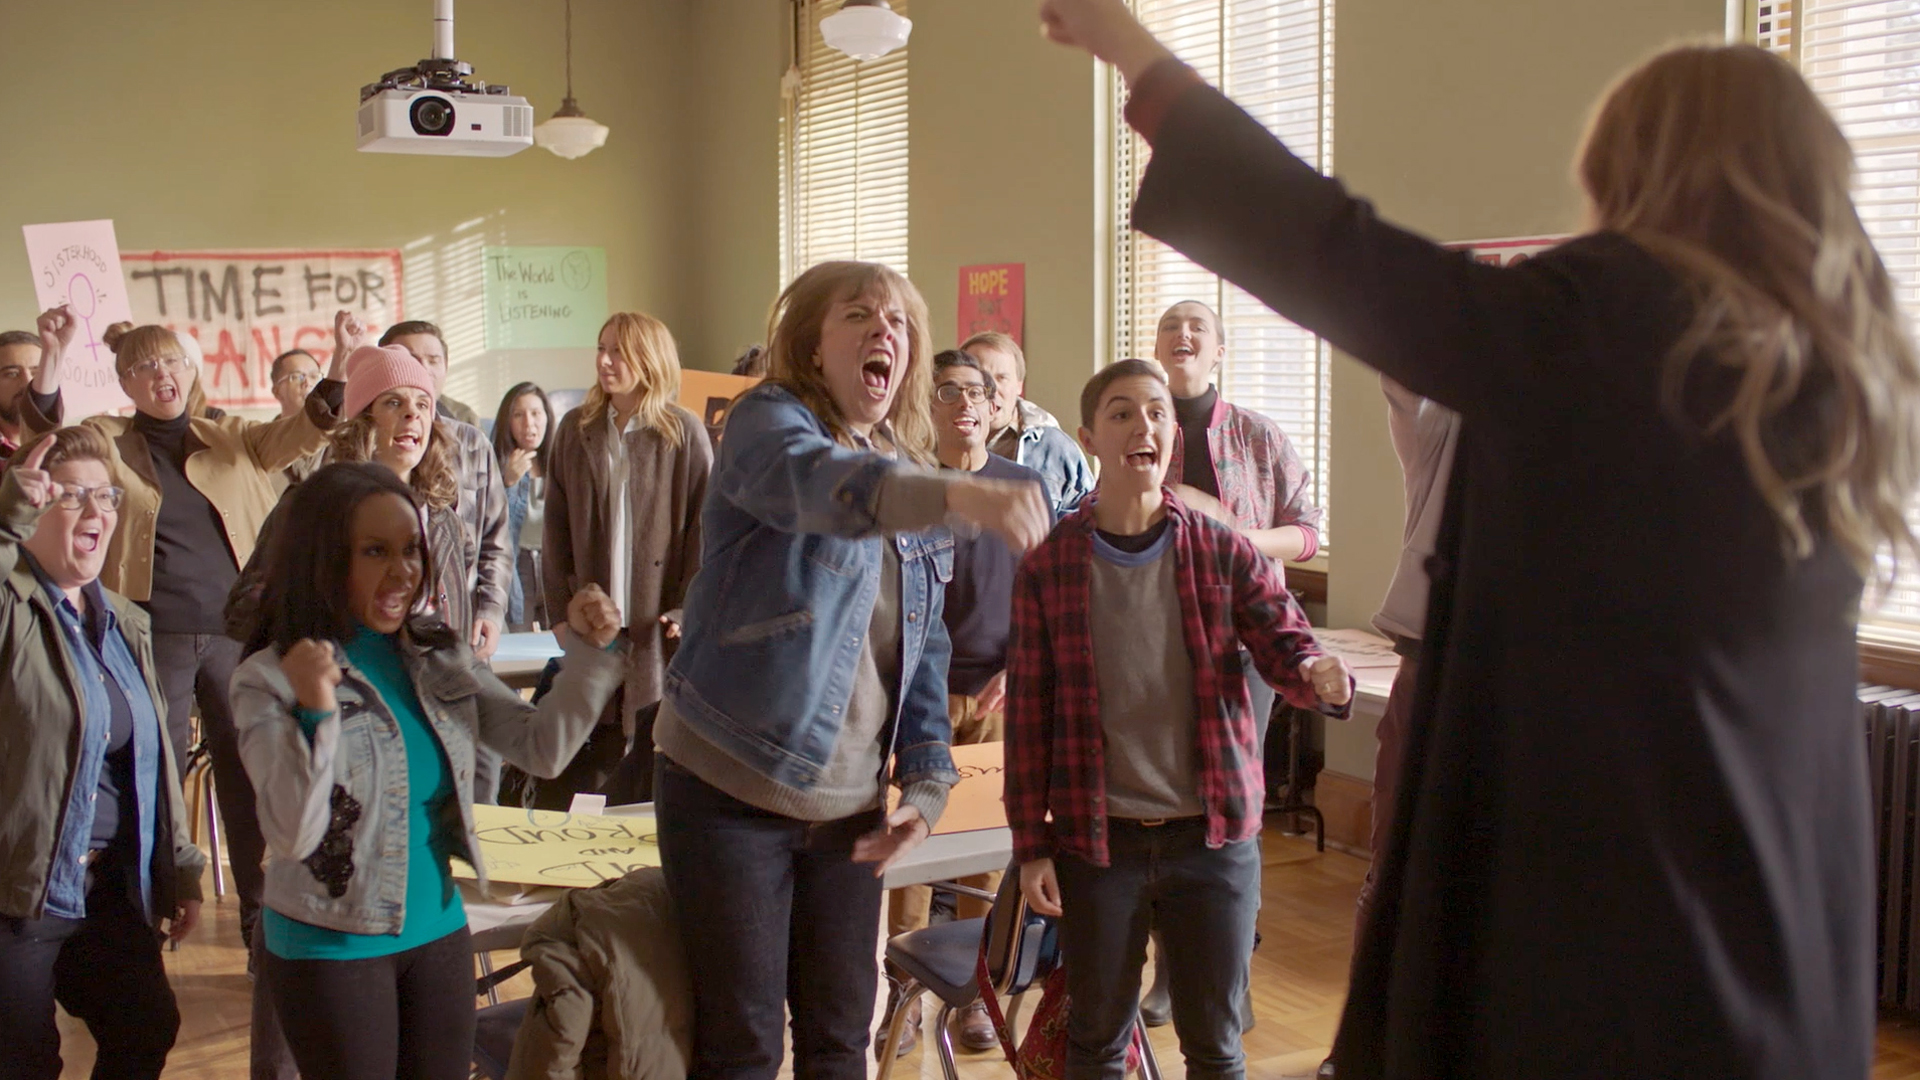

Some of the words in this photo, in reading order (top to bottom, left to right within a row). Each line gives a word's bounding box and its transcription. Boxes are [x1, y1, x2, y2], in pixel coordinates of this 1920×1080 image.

[43, 244, 108, 288] SISTERHOOD
[487, 255, 517, 282] The
[518, 261, 555, 284] World
[131, 264, 285, 322] TIME
[303, 264, 387, 311] FOR
[969, 269, 1008, 295] HOPE
[500, 304, 572, 323] LISTENING
[63, 357, 118, 388] SOLIDA
[578, 847, 636, 857] AND
